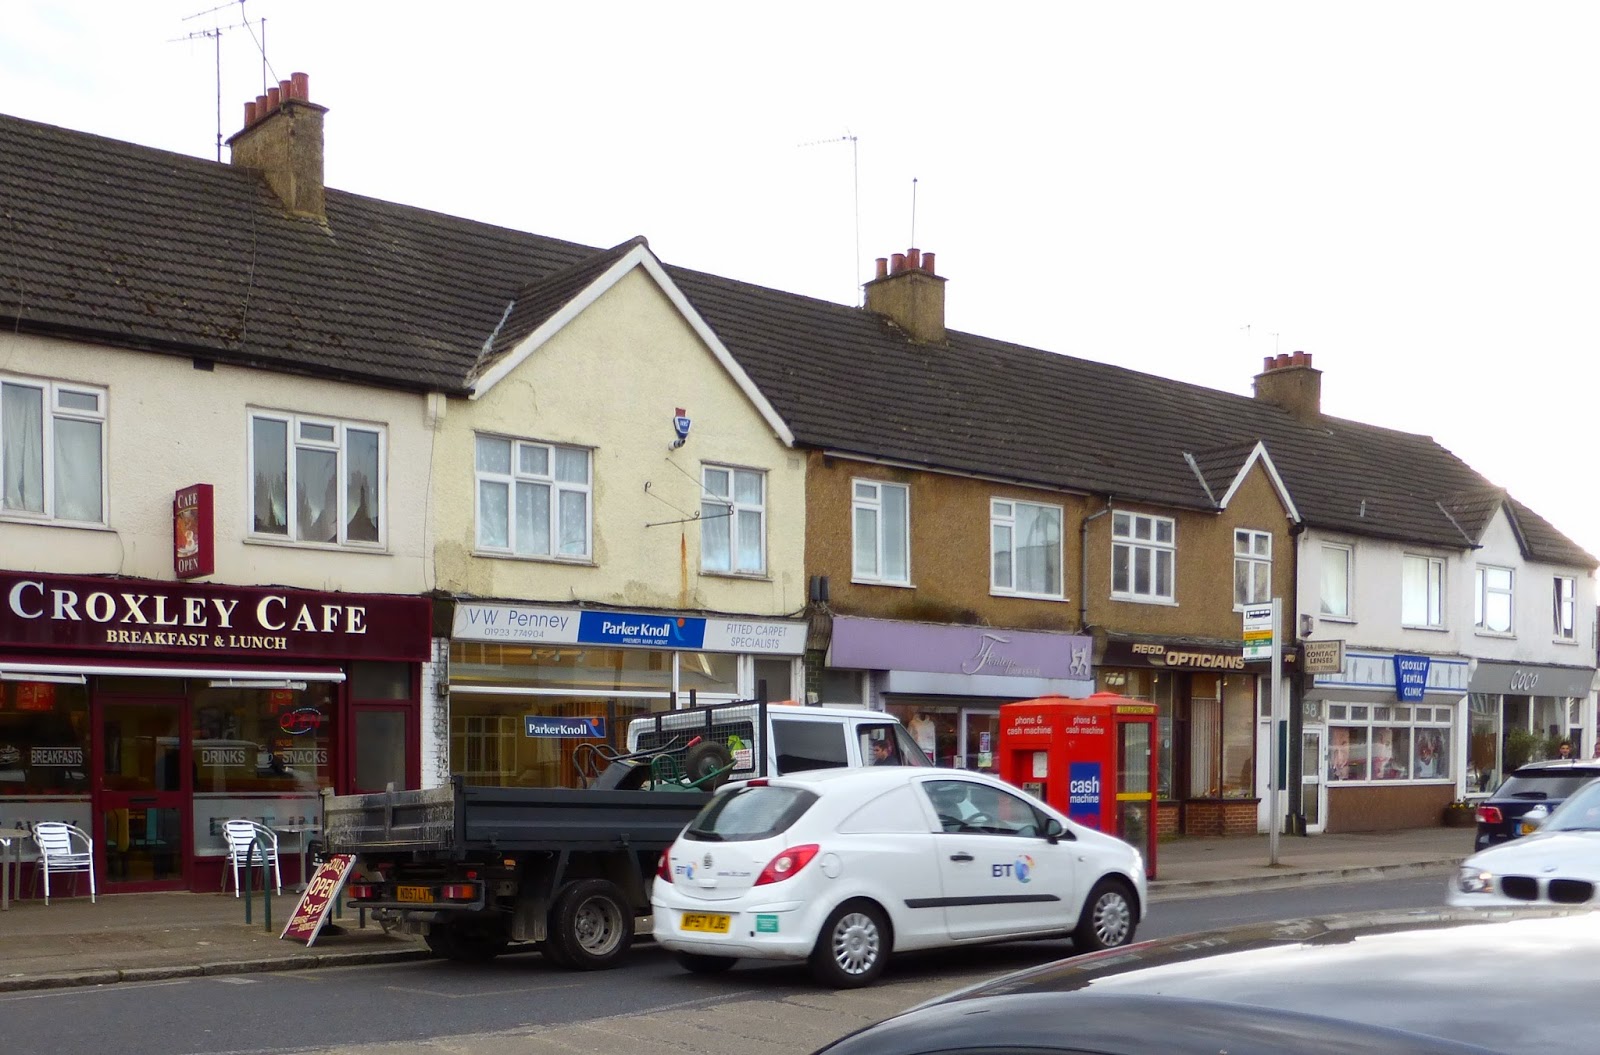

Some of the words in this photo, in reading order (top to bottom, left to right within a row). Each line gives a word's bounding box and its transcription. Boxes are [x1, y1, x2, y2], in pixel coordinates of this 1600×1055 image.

[178, 493, 198, 508] CAFE
[178, 559, 198, 572] OPEN
[9, 581, 239, 628] CROXLEY
[256, 595, 367, 634] CAFE
[508, 610, 569, 631] Penney
[484, 628, 510, 637] 01923
[513, 629, 544, 638] 774904
[726, 623, 753, 635] FITTED
[755, 625, 787, 637] CARPET
[106, 630, 209, 647] BREAKFAST
[214, 636, 225, 647] &
[230, 636, 287, 650] LUNCH
[731, 637, 779, 649] SPECIALISTS
[1132, 643, 1166, 655] REGD.
[1166, 651, 1245, 669] OPTICIANS
[1306, 650, 1337, 658] CONTACT
[1401, 660, 1427, 671] CROXLEY
[1402, 674, 1424, 684] DENTAL
[1404, 687, 1422, 697] CLINIC
[281, 712, 321, 728] OPEN
[1015, 716, 1035, 725] phone
[1036, 715, 1043, 724] &
[1073, 716, 1091, 725] phone
[1091, 716, 1097, 724] &
[1007, 727, 1022, 735] cash
[1024, 726, 1052, 735] machine
[1066, 726, 1080, 734] cash
[1081, 726, 1104, 735] machine
[31, 750, 83, 764] BREAKFASTS
[202, 750, 245, 763] DRINKS
[282, 751, 328, 763] SNACKS
[1070, 776, 1099, 793] cash
[1070, 794, 1099, 804] machine
[992, 864, 1013, 878] BT
[309, 876, 339, 899] OPEN
